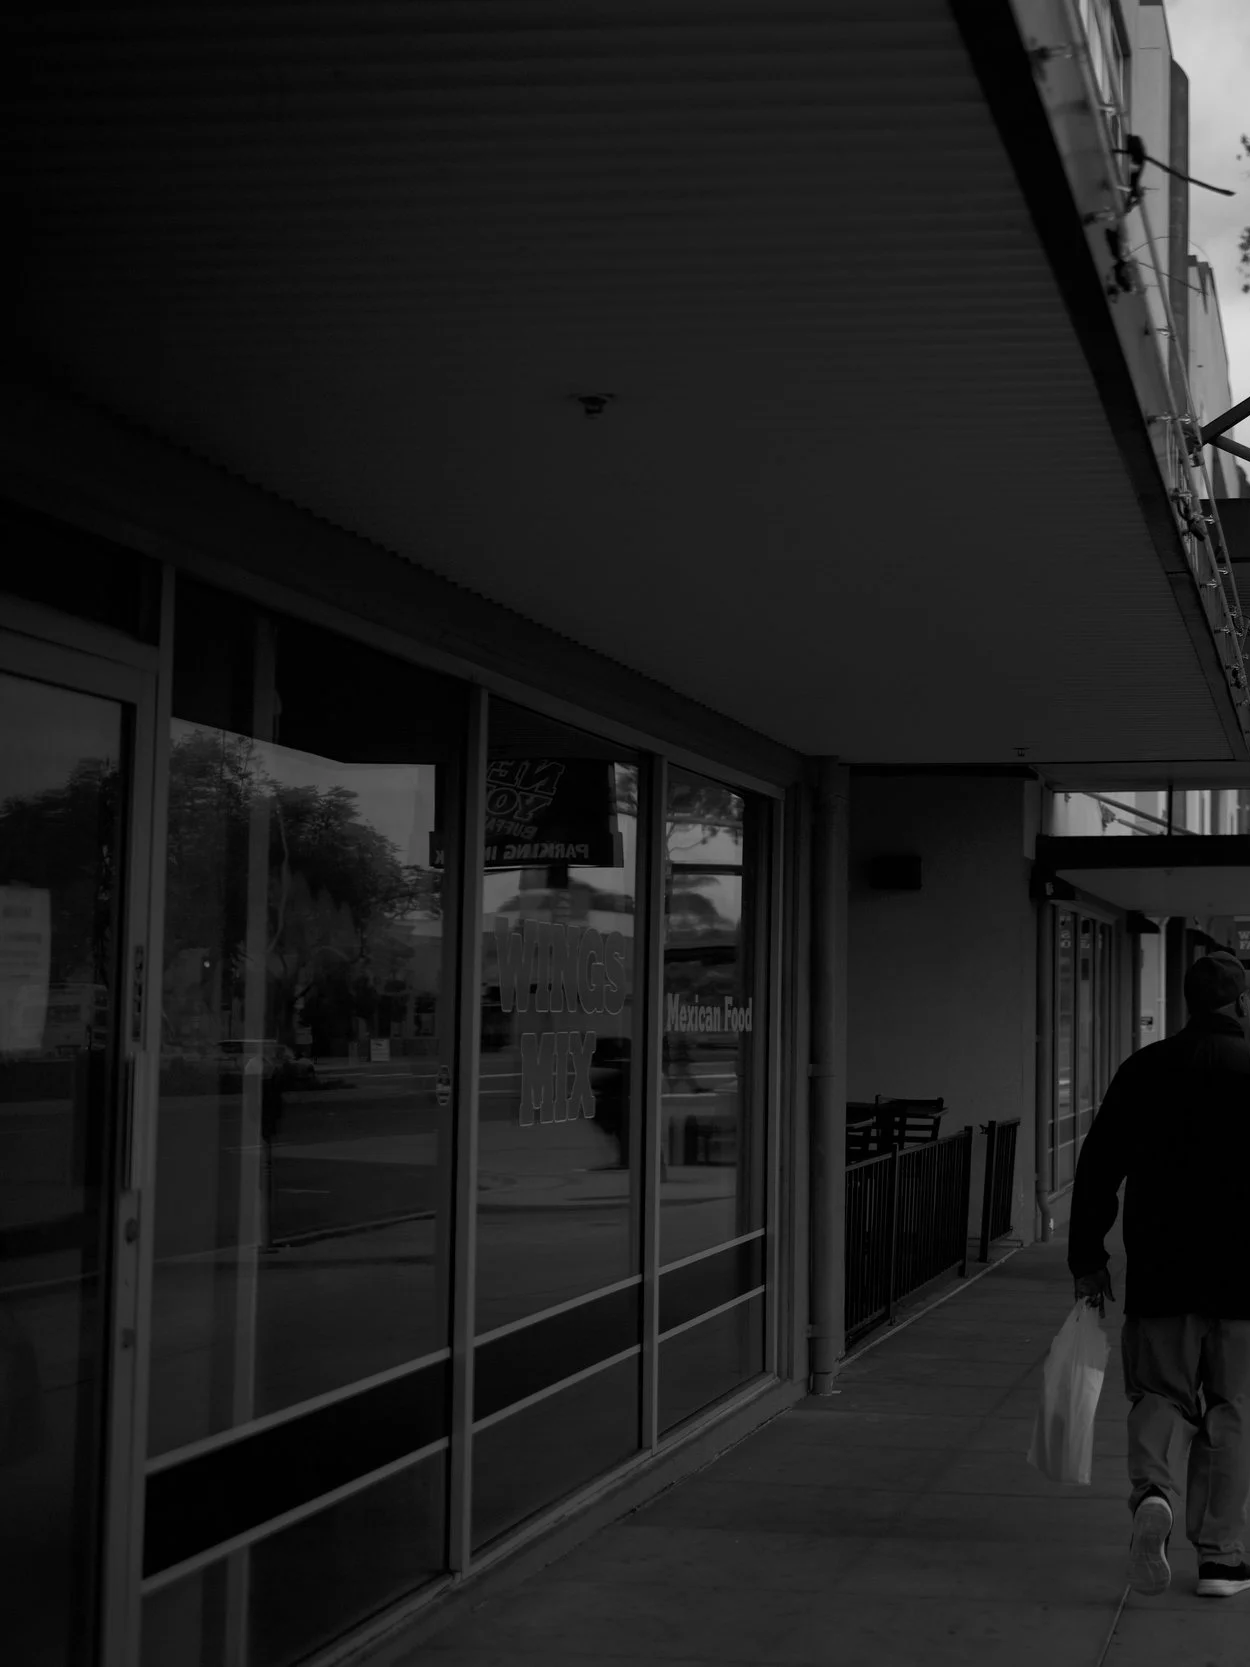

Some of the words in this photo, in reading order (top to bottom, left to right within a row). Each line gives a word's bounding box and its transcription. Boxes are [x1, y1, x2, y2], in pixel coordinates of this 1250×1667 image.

[493, 917, 626, 1016] WINGS
[666, 993, 721, 1033] Mexican
[723, 995, 753, 1033] Food
[519, 1030, 598, 1128] MIX
